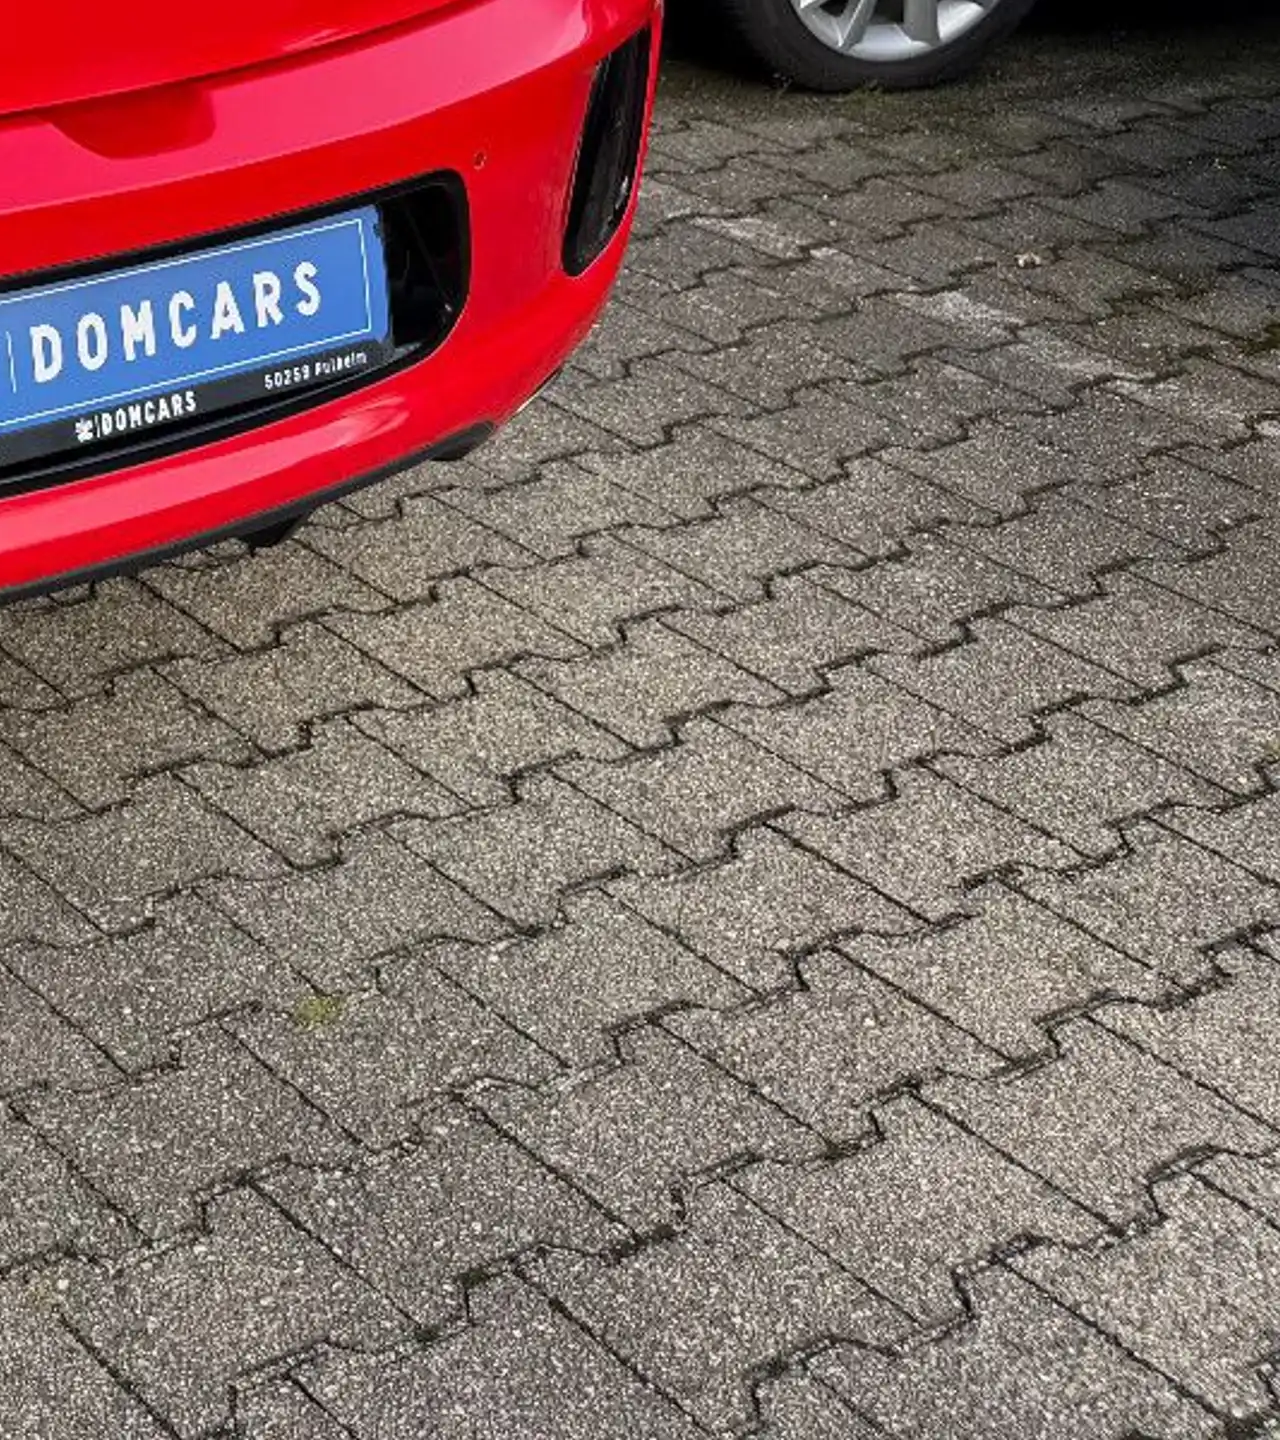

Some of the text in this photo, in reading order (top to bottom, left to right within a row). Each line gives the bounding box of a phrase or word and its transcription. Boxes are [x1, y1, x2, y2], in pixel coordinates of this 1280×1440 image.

[29, 261, 321, 383] DOMCARS
[264, 364, 310, 391] 50259
[101, 390, 197, 436] DOMCARS
